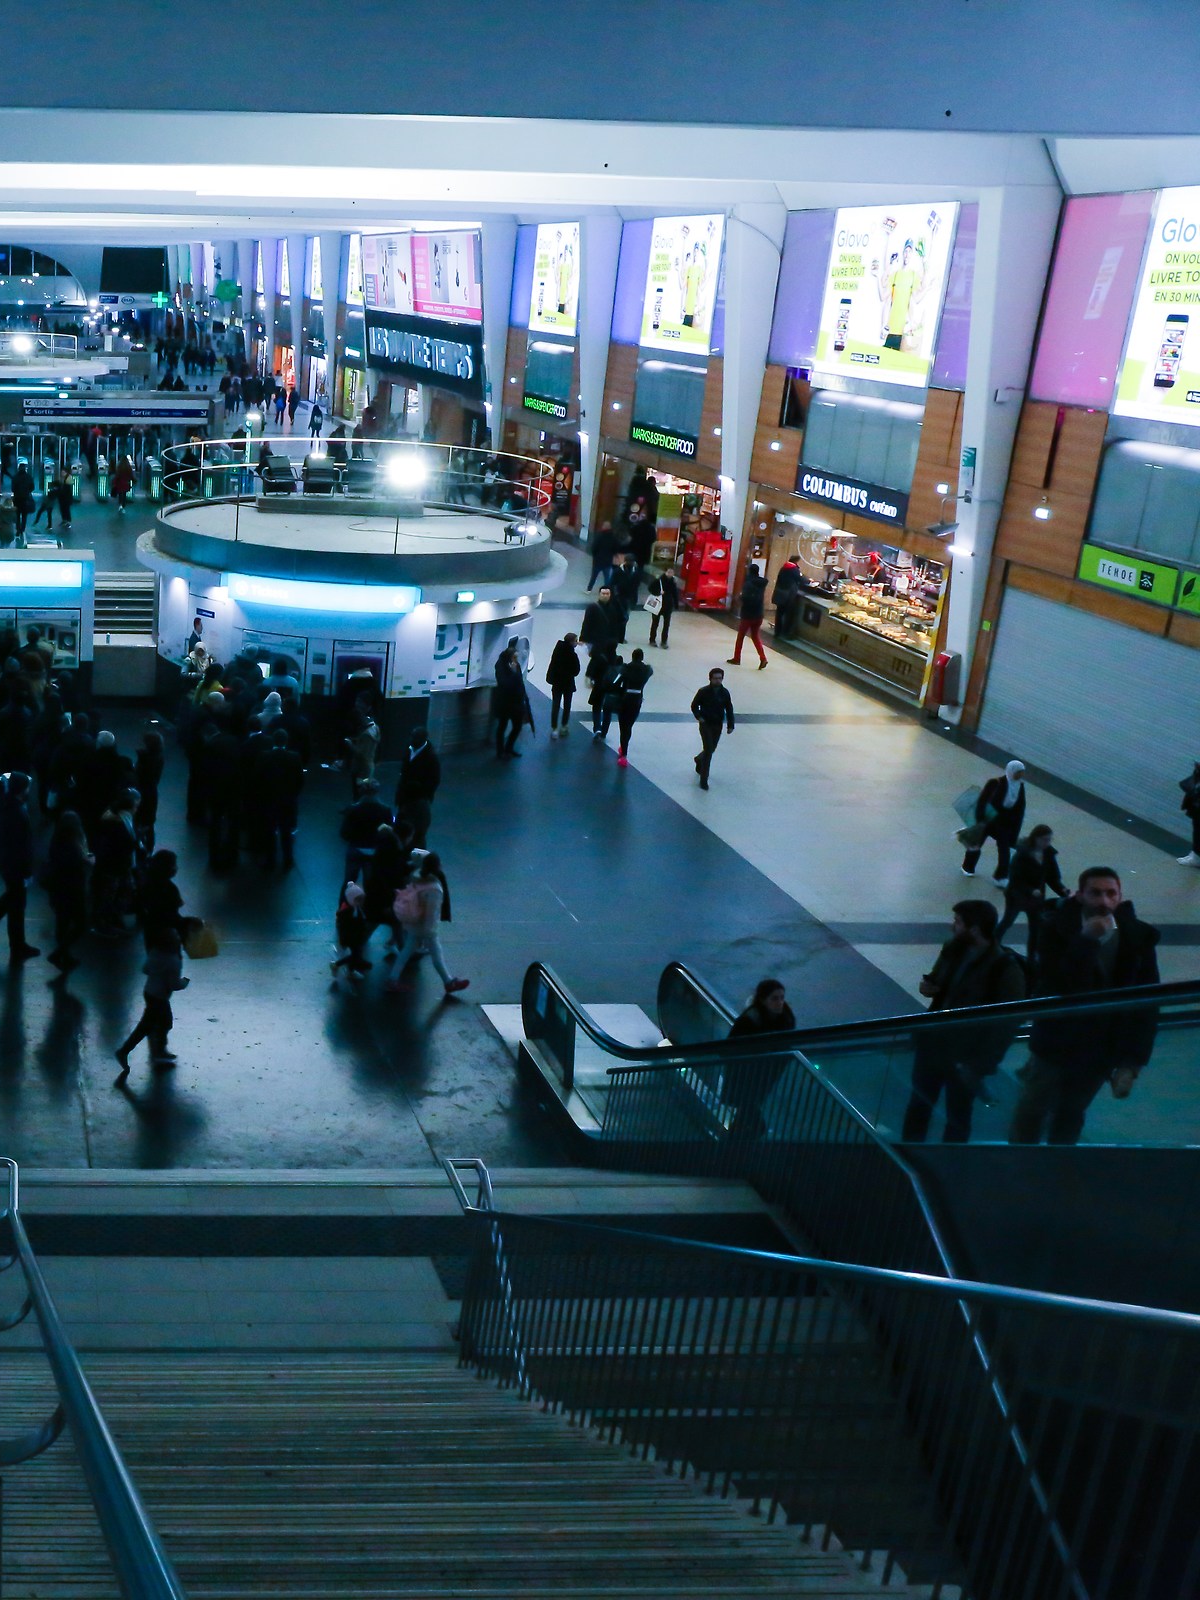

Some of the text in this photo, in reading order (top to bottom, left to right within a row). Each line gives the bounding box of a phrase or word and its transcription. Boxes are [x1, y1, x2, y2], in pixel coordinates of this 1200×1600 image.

[1161, 217, 1200, 243] Glo
[837, 229, 870, 248] Glovo
[1165, 253, 1180, 264] ON
[831, 266, 866, 277] LIVRE TOUT
[1150, 271, 1182, 284] LIVRE
[1154, 291, 1167, 302] EN
[1169, 291, 1182, 303] 30
[802, 473, 868, 509] COLUMBUS
